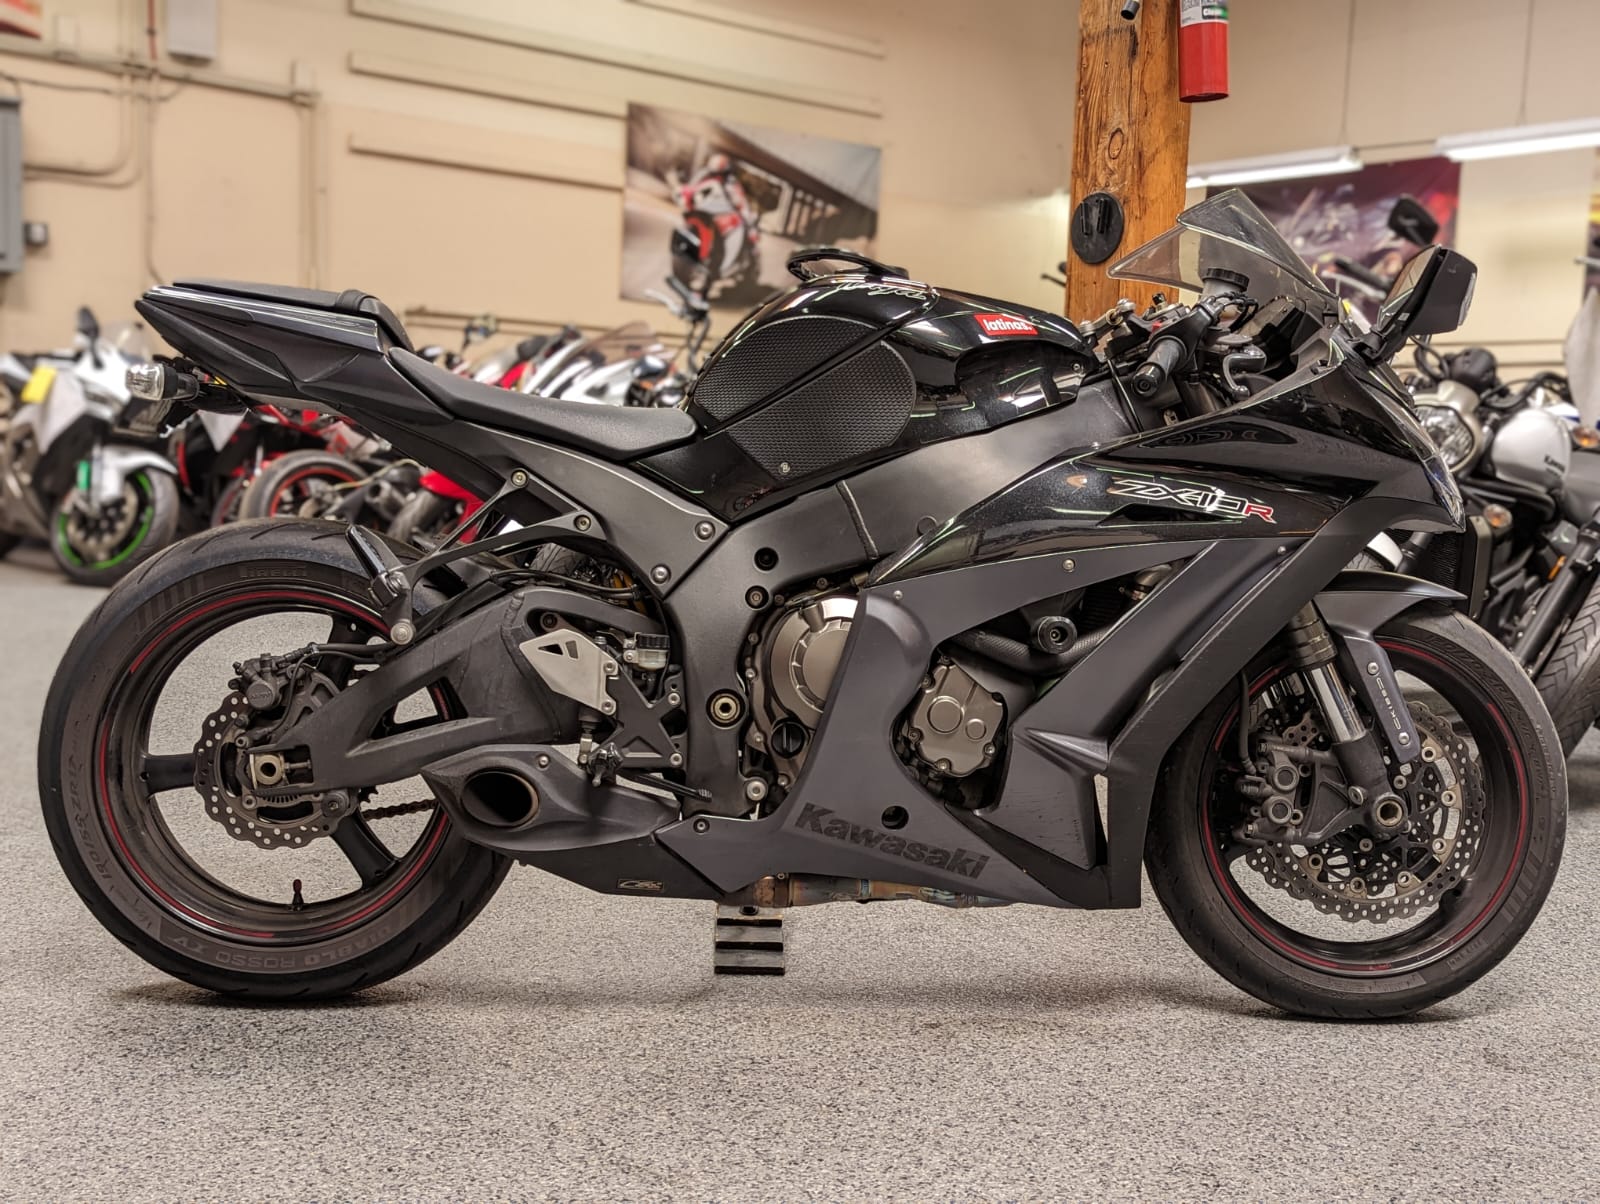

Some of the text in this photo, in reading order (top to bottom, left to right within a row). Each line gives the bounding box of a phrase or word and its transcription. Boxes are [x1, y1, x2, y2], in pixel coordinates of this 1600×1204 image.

[795, 802, 991, 880] Kawasaki
[214, 949, 296, 970] ROSSO
[303, 924, 391, 968] DIABLO
